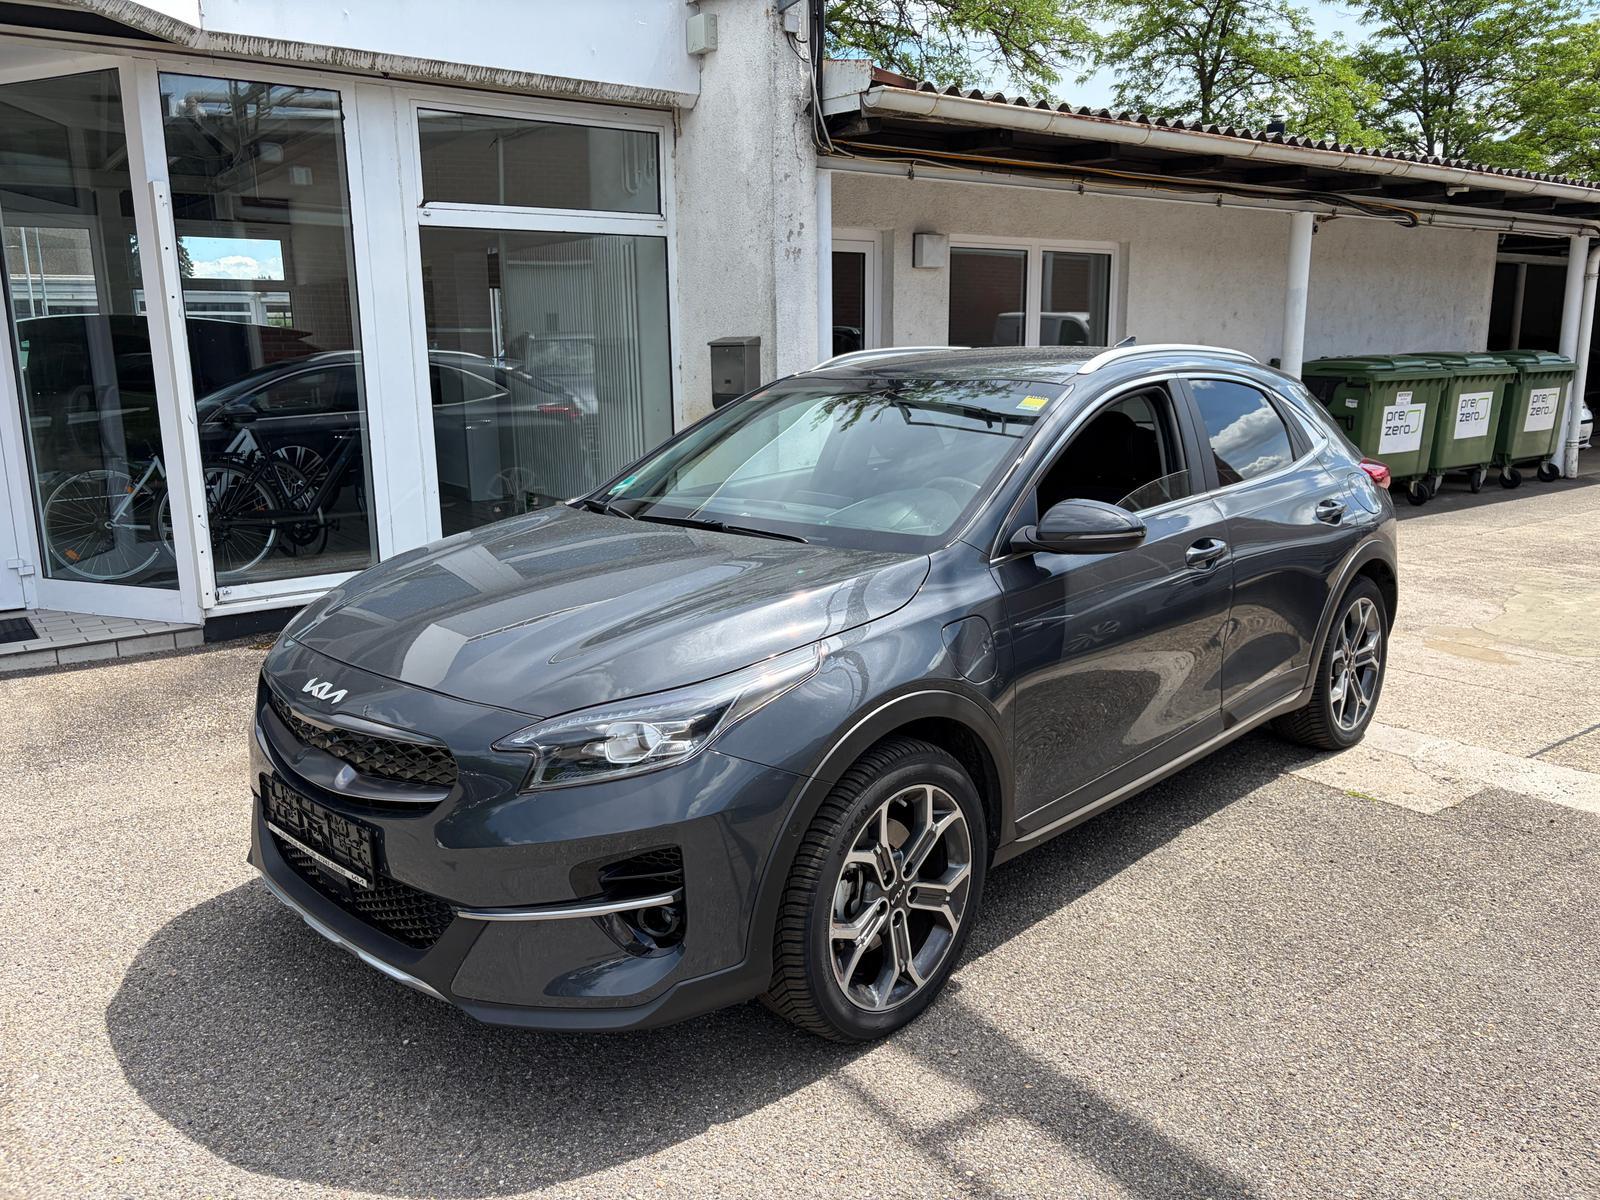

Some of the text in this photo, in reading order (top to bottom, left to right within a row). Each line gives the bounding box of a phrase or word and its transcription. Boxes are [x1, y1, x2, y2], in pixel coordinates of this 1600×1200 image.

[1460, 398, 1477, 411] pre
[1532, 393, 1548, 406] pre
[1386, 410, 1406, 424] pre
[1459, 411, 1480, 422] zero
[1529, 406, 1550, 416] zero
[1384, 424, 1411, 436] zero
[301, 677, 348, 704] KIA
